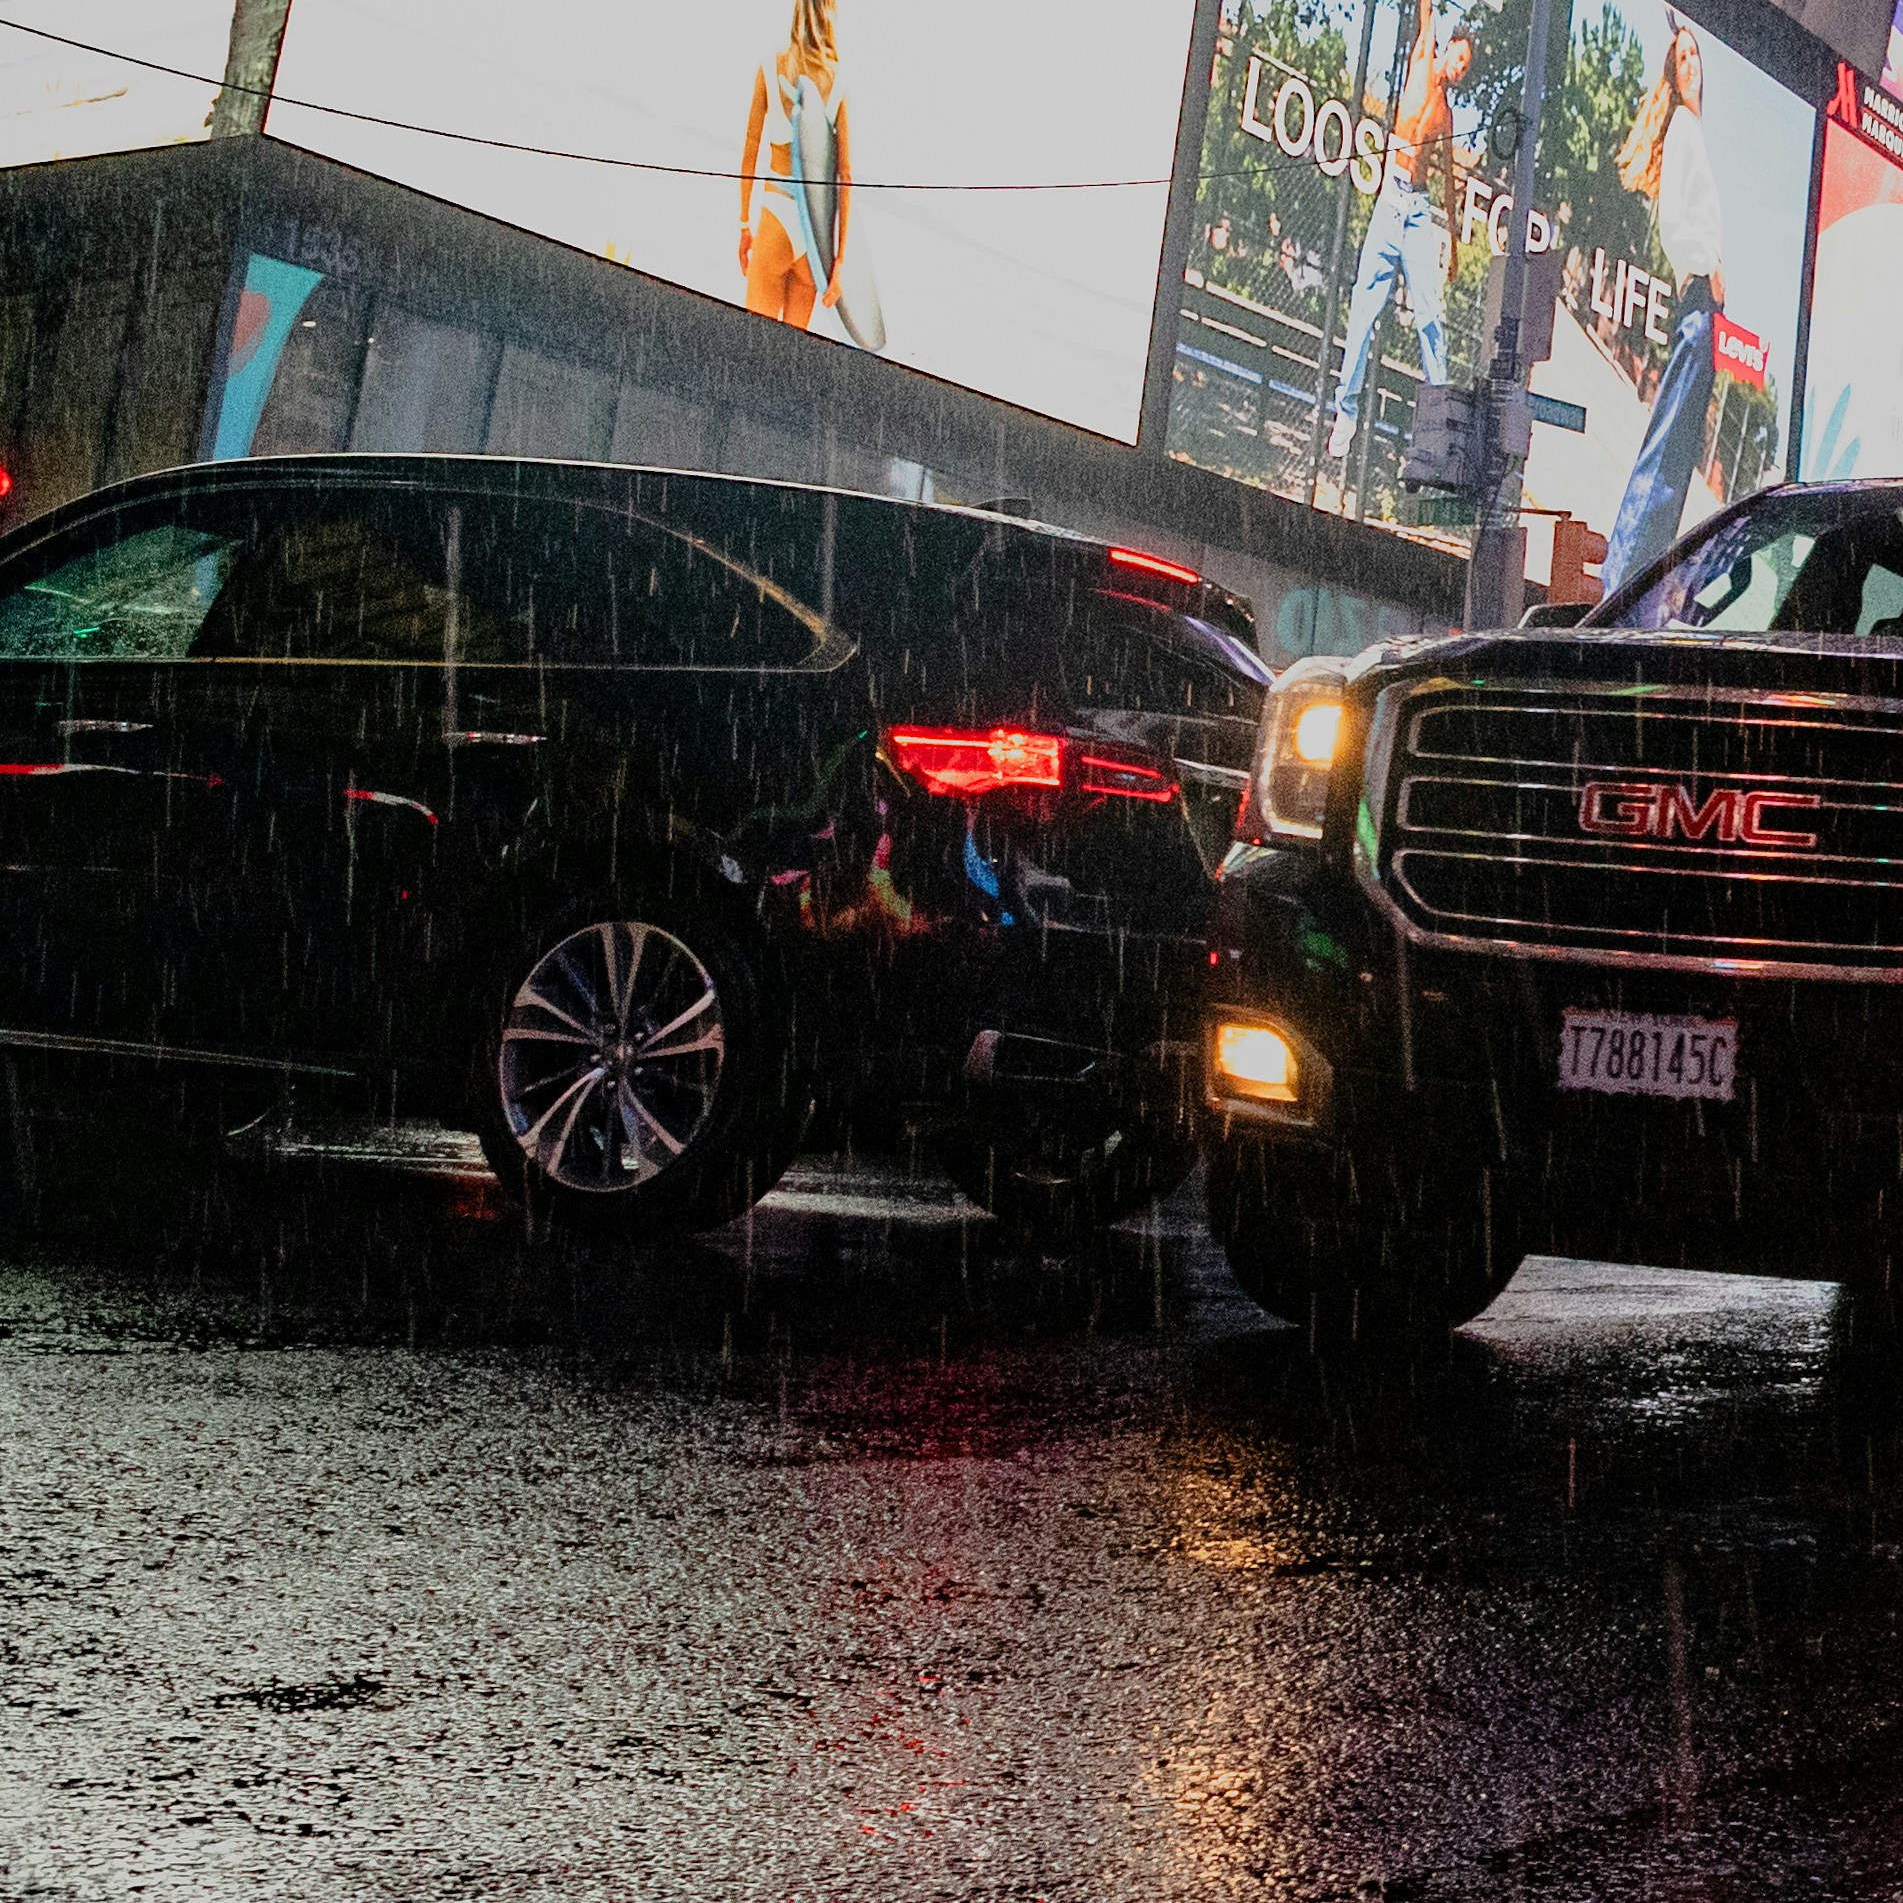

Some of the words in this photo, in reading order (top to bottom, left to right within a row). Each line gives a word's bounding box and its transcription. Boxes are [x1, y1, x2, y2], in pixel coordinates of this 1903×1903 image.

[1590, 248, 1673, 345] LIFE
[1578, 781, 1821, 847] GMC
[1568, 1025, 1728, 1087] T788145C
